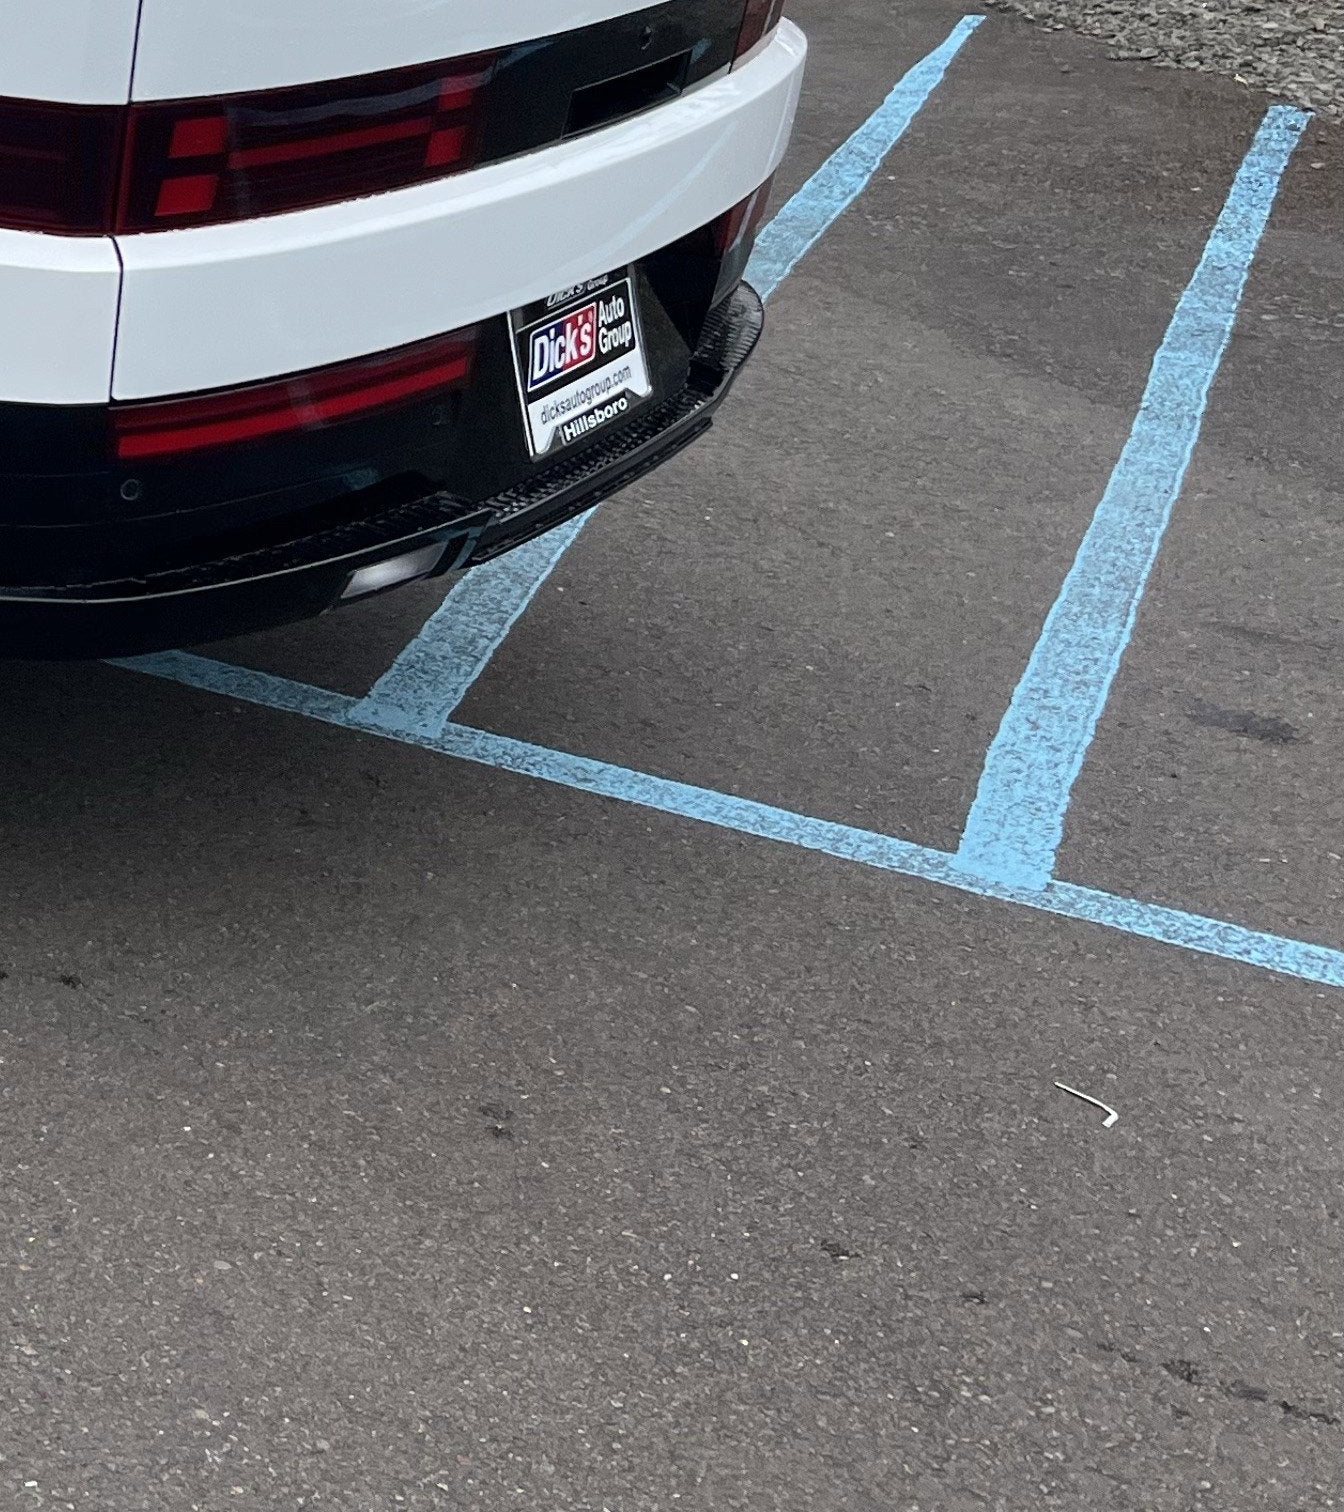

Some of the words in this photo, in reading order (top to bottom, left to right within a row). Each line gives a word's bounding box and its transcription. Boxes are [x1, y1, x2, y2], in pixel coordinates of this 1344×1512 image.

[598, 295, 625, 328] Auto
[532, 315, 592, 382] Dick's
[598, 321, 633, 355] Group
[540, 366, 632, 425] dicksautogroup.com
[563, 396, 628, 442] Hillsboro
